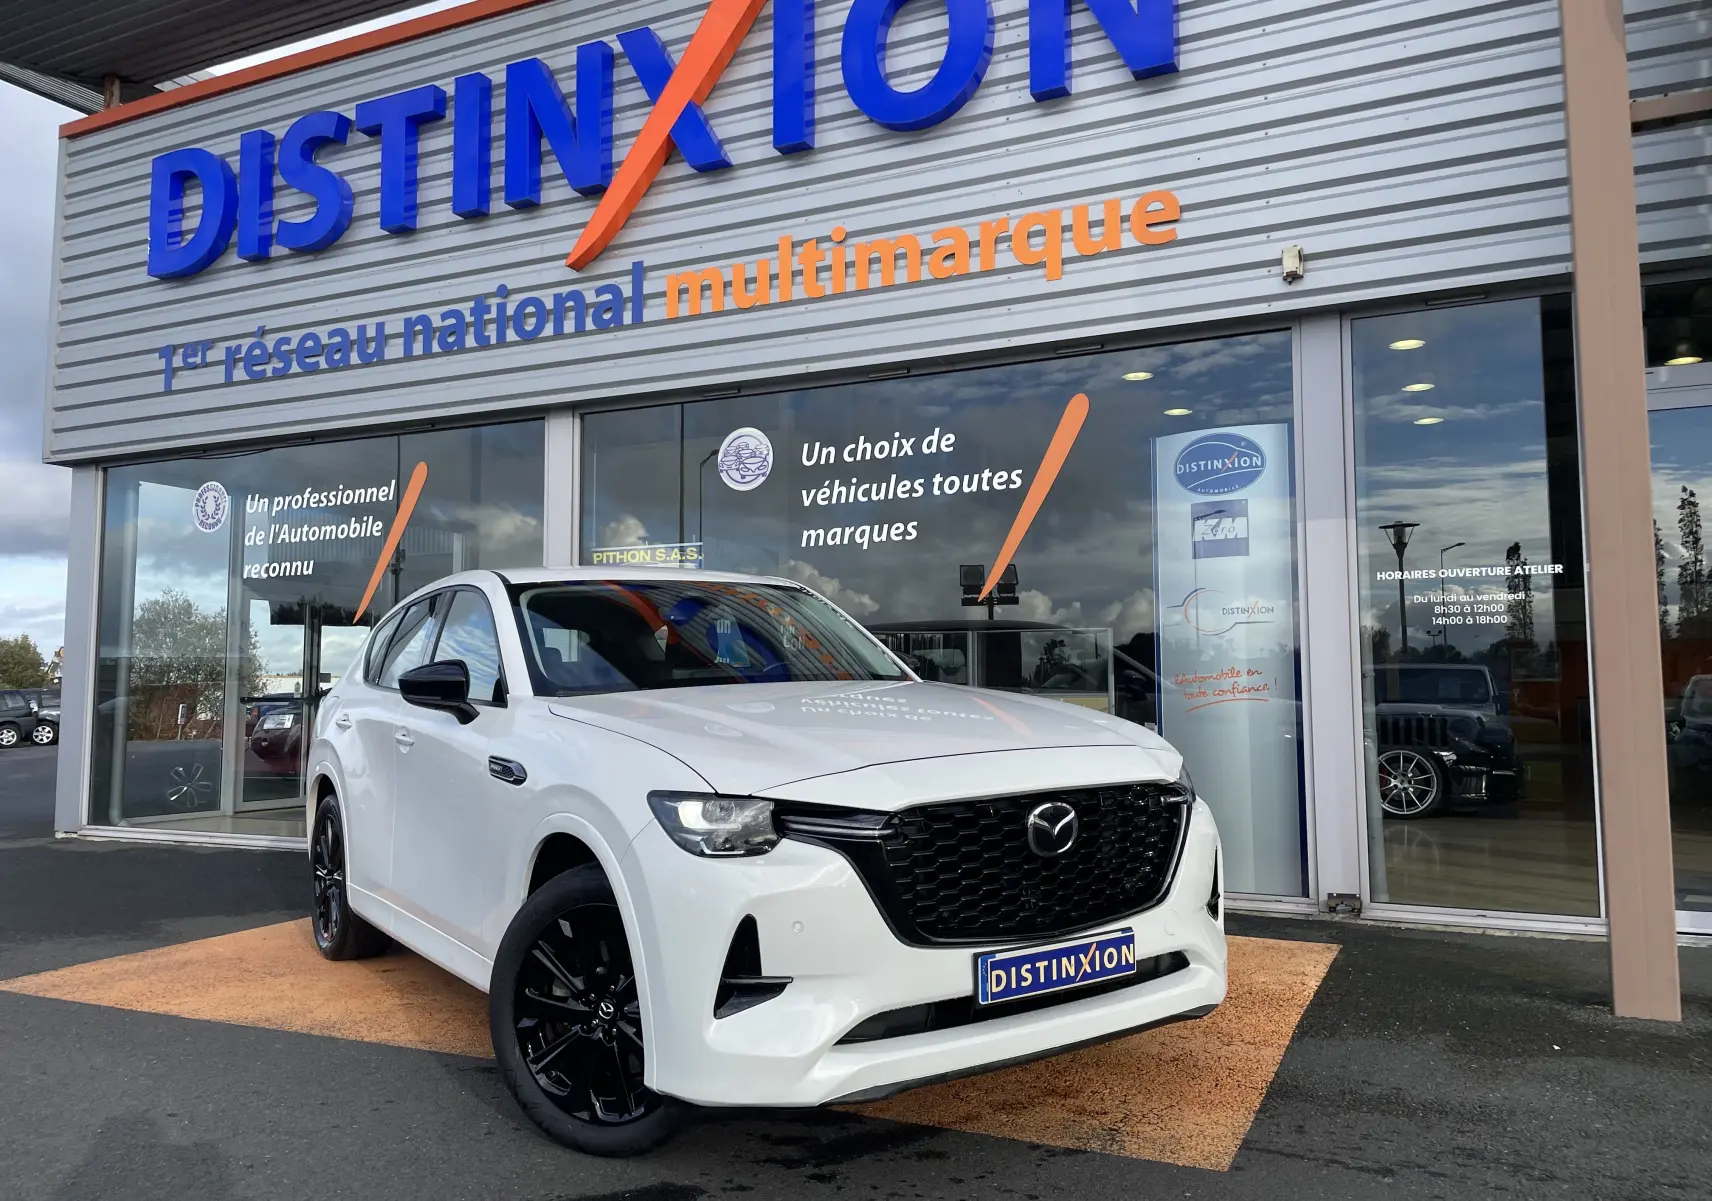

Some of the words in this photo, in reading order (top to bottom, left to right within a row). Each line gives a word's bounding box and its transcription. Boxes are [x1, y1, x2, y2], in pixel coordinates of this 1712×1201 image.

[158, 339, 214, 392] 1er
[225, 325, 387, 383] réseau
[403, 260, 645, 358] national
[665, 190, 1182, 319] multimarque
[801, 441, 836, 467] Un
[842, 431, 916, 463] choix
[921, 427, 956, 454] de
[1176, 450, 1262, 475] DISTINXION
[801, 474, 925, 507] véhicules
[932, 468, 1023, 496] toutes
[1197, 484, 1240, 494] AUTOMOBILE
[246, 493, 269, 514] Un
[272, 479, 396, 517] professionnel
[244, 525, 266, 547] de
[268, 515, 384, 545] l'Automobile
[801, 521, 919, 550] marques
[593, 549, 651, 565] PITHON
[655, 546, 703, 561] S.A.S.
[243, 559, 315, 579] reconnu
[1376, 570, 1437, 581] HORAIRES
[1439, 566, 1512, 578] OUVERTURE
[1514, 564, 1564, 575] ATELIER
[1413, 595, 1428, 604] Du
[1430, 594, 1457, 603] lundi
[1476, 592, 1526, 602] vendredi
[1221, 600, 1275, 618] DISTINXION
[1434, 605, 1461, 614] 8h30
[1464, 603, 1471, 614] à
[1474, 603, 1505, 613] 12h00
[1431, 616, 1463, 626] 14h00
[1465, 615, 1473, 625] à
[1476, 615, 1508, 624] 18h00
[1246, 668, 1263, 677] en
[1183, 685, 1209, 700] toute
[1212, 681, 1271, 697] confiance
[991, 942, 1135, 993] DISTINXION
